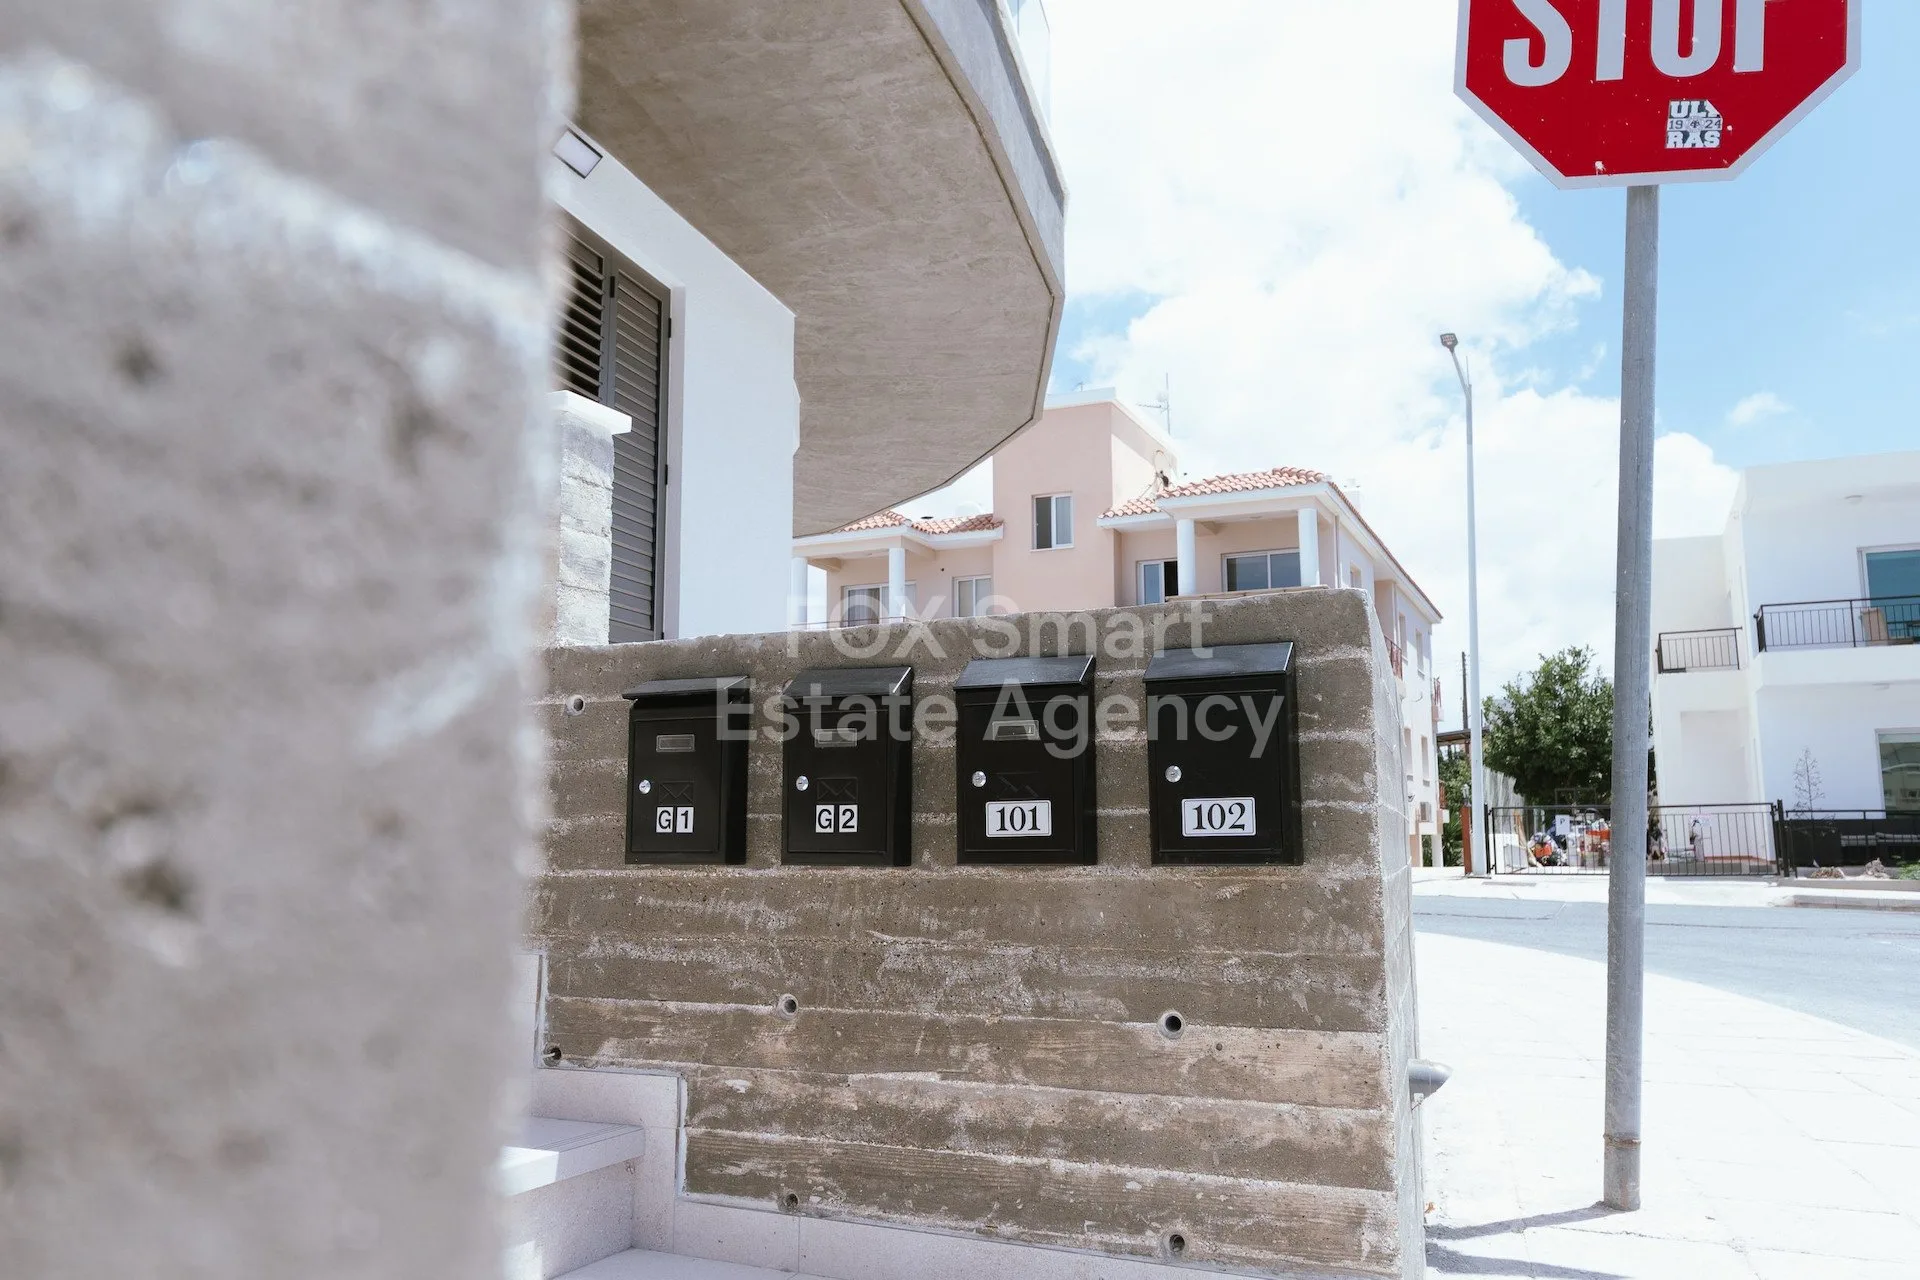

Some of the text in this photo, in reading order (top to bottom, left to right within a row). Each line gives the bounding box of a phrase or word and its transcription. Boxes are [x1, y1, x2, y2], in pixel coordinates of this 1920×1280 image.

[1669, 119, 1722, 130] 19 24
[1667, 130, 1721, 148] RAS
[657, 808, 691, 831] G1
[816, 807, 857, 831] G2
[995, 805, 1042, 833] 101
[1192, 802, 1247, 832] 102
